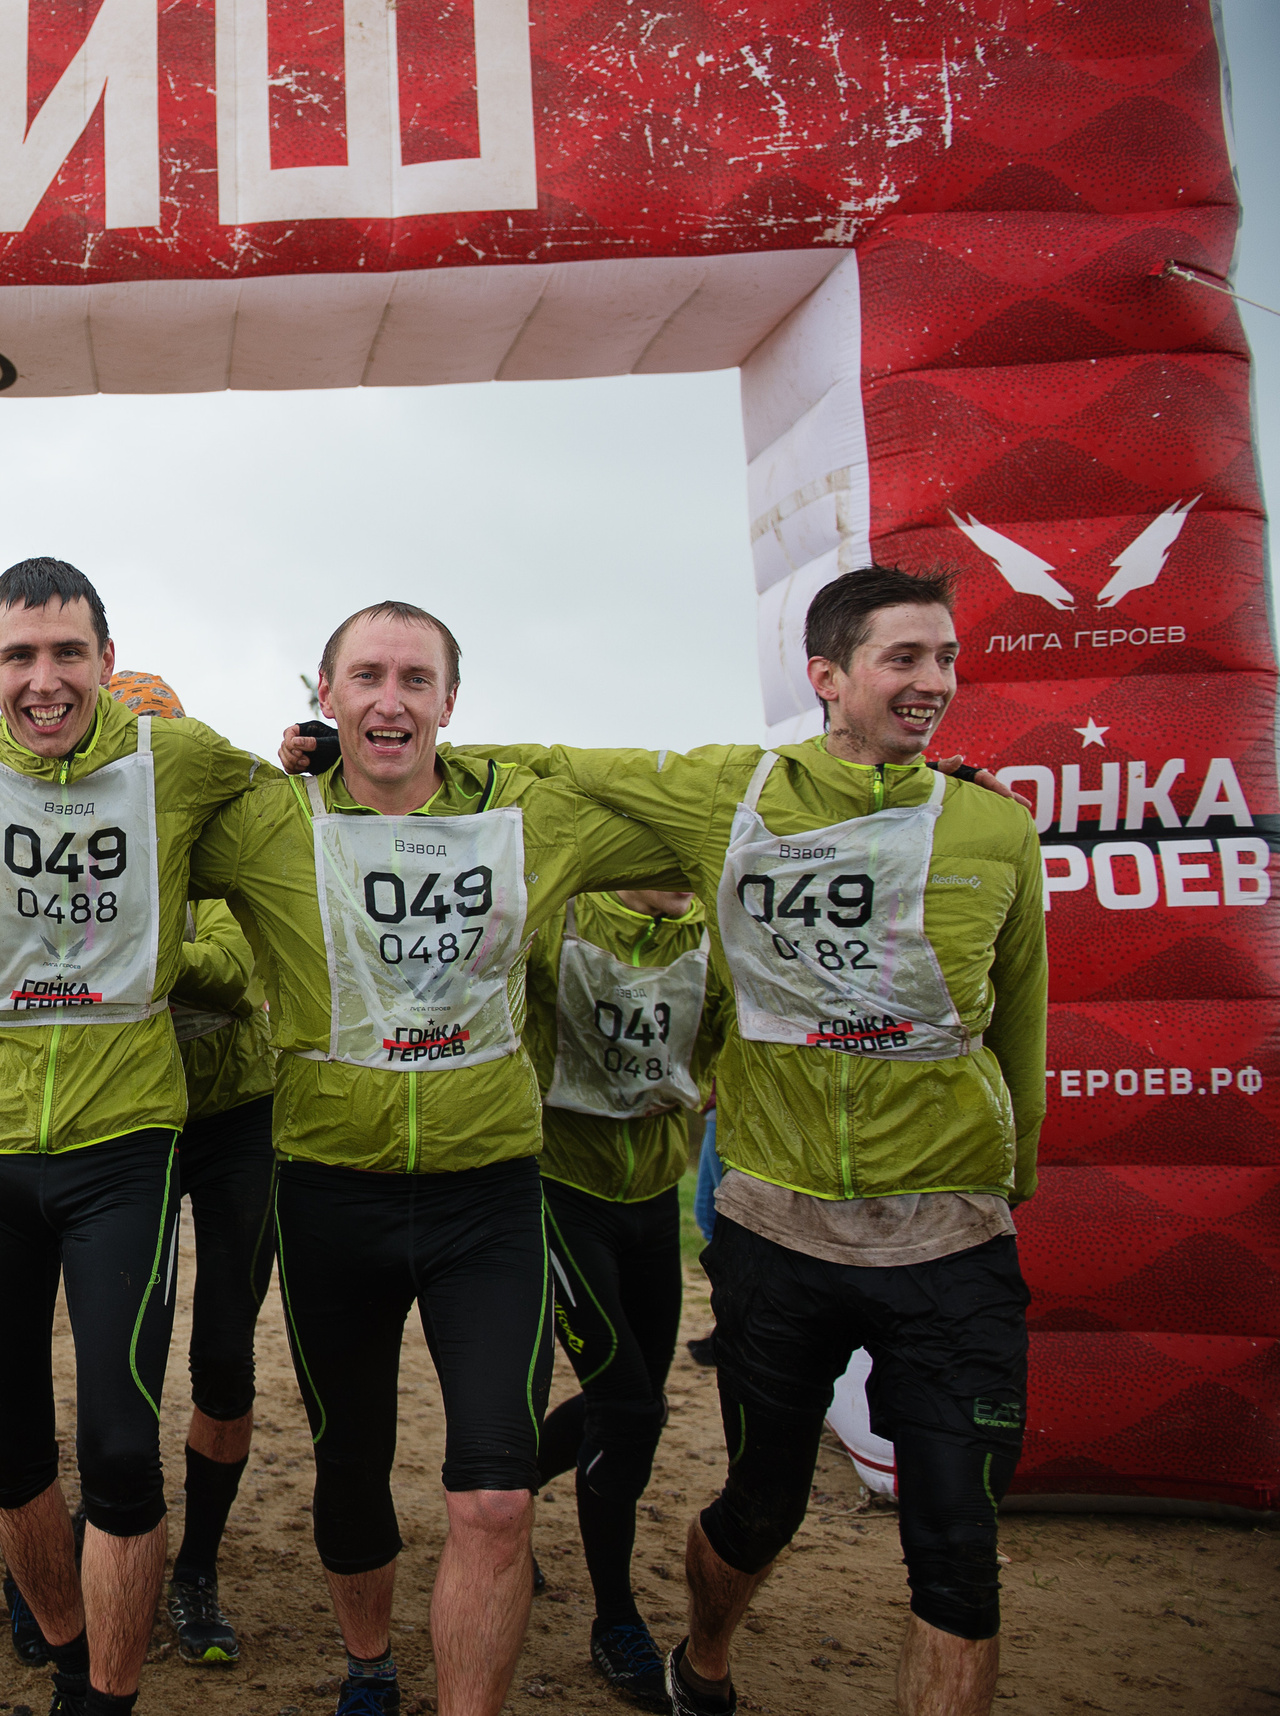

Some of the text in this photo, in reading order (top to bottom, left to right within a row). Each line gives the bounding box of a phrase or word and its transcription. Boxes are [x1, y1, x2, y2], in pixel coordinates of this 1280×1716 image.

[985, 625, 1186, 655] ЛИГА ГЕРОЕВ
[982, 757, 1255, 835] ОНКА
[3, 823, 127, 883] 049
[394, 839, 447, 857] Взвод
[1040, 837, 1272, 912] РОЕВ
[17, 887, 118, 925] 0488
[363, 865, 493, 924] 049
[736, 873, 875, 929] 049
[379, 926, 484, 965] 0487
[772, 933, 878, 971] 082
[21, 978, 90, 997] ГОНКА
[395, 1023, 462, 1045] ГОНКА
[594, 999, 671, 1047] 049
[818, 1014, 899, 1037] ГОНКА
[387, 1038, 466, 1062] ГЕРОЕВ
[1045, 1065, 1263, 1097] ЕРОЕВ.РФ
